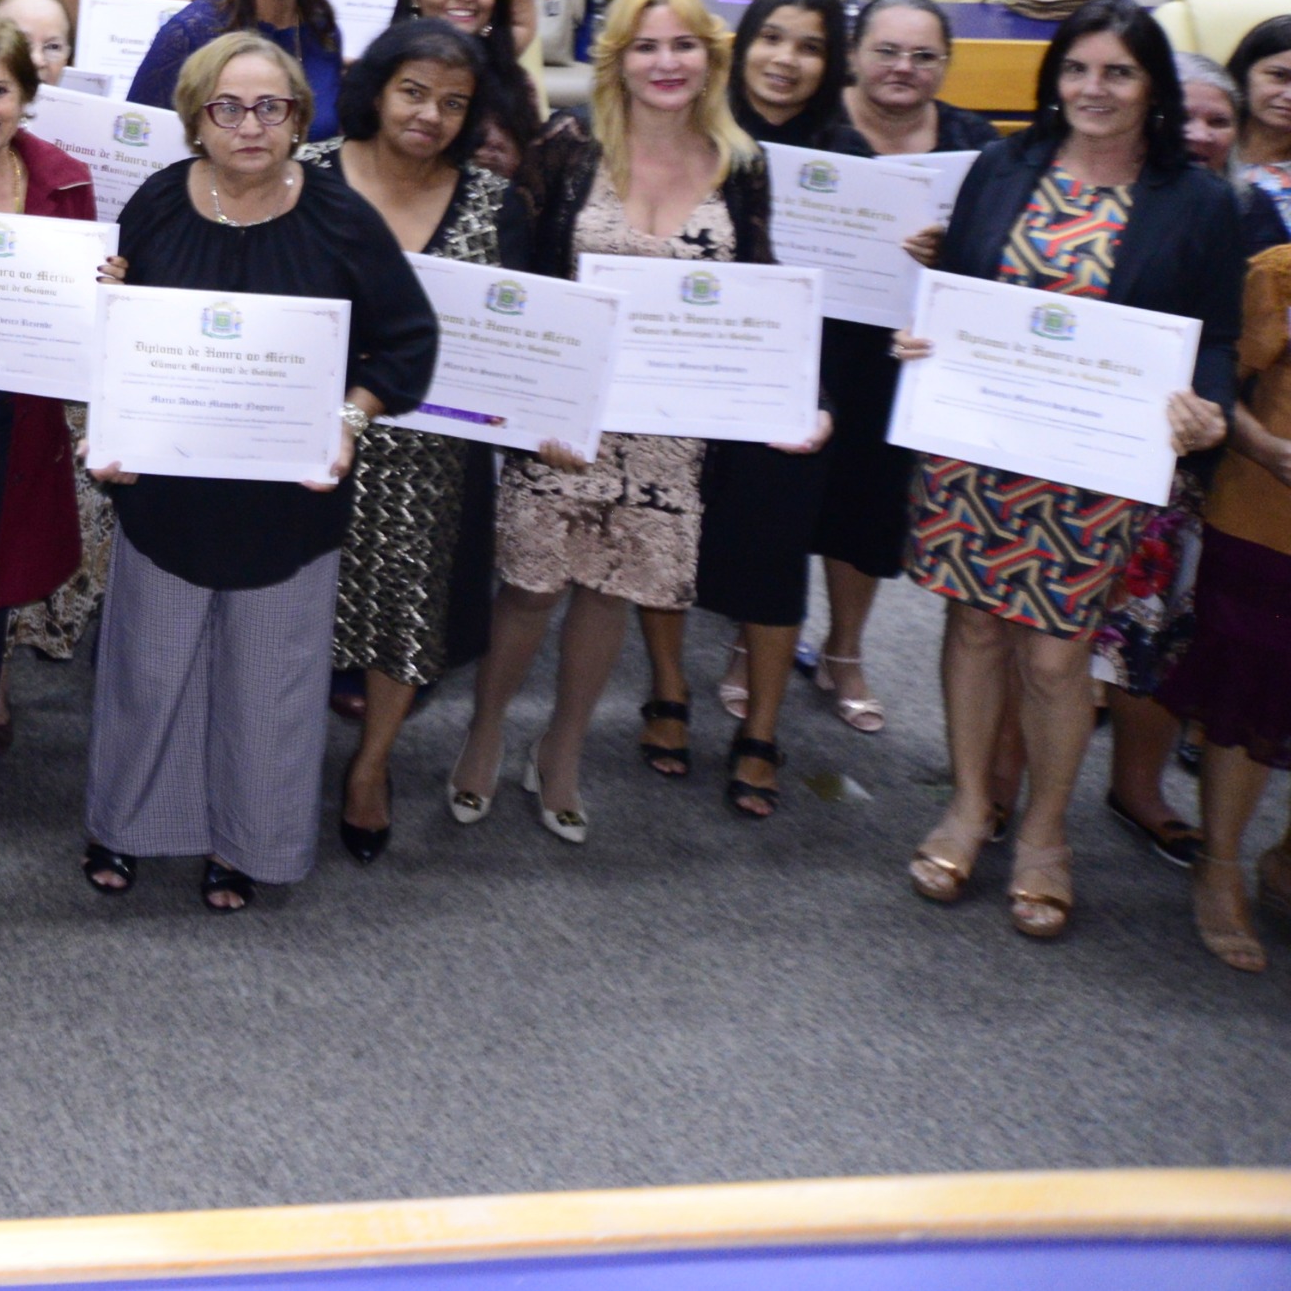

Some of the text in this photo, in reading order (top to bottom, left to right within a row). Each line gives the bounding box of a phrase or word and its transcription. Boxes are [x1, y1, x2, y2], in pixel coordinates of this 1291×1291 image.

[19, 270, 31, 279] ao
[36, 270, 74, 284] Mérito
[135, 340, 305, 364] Diploma de Honra ao Mérito
